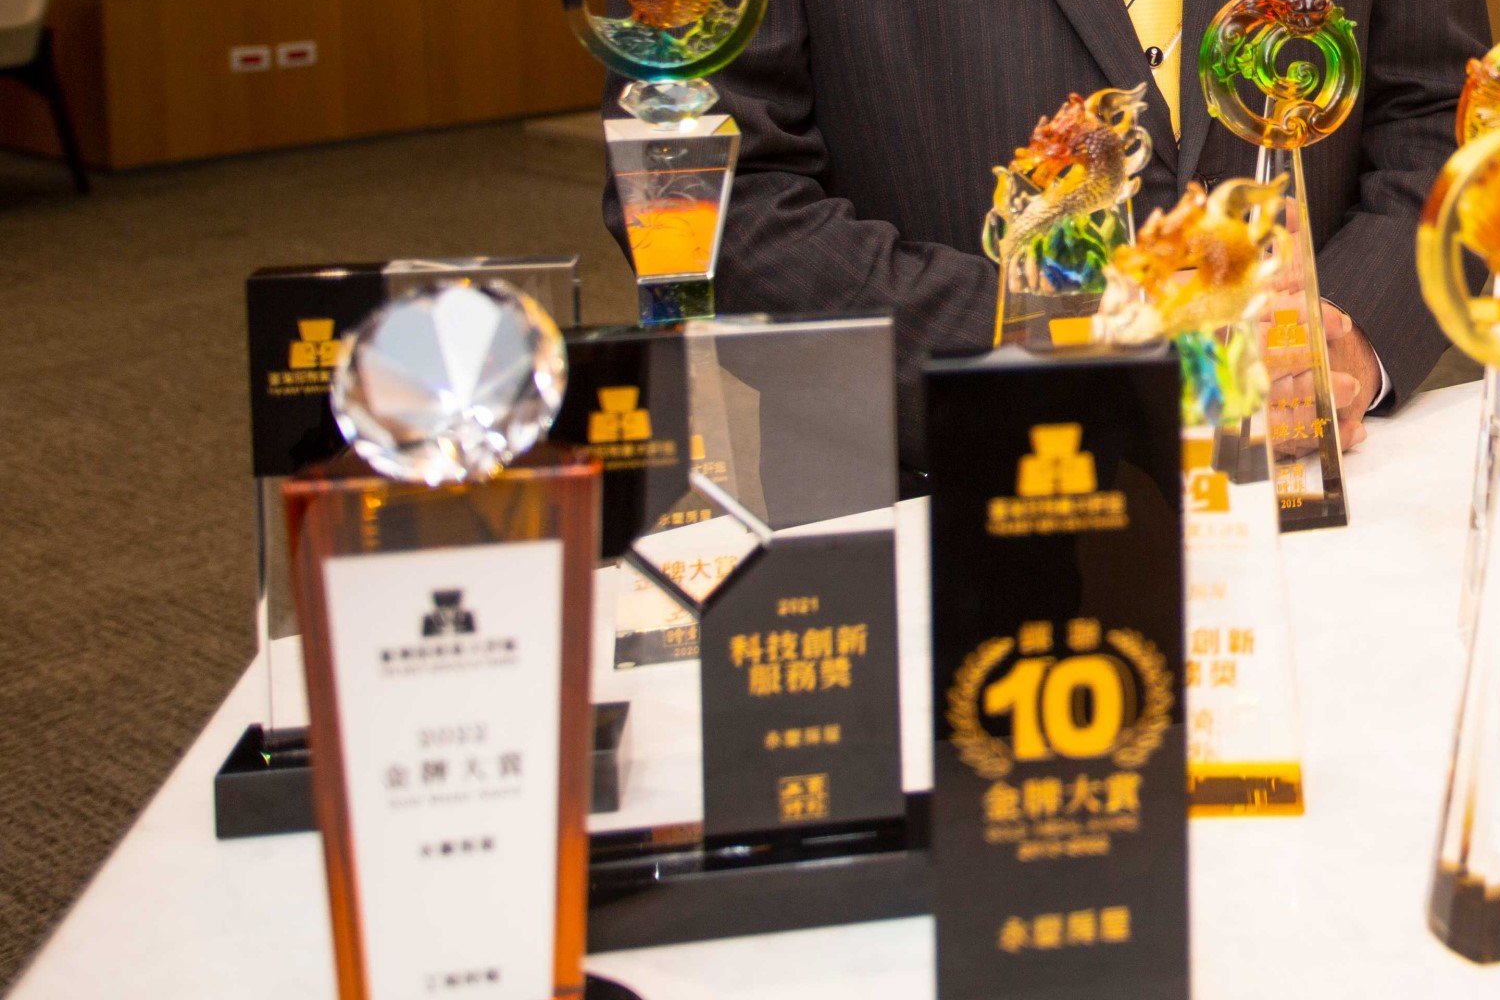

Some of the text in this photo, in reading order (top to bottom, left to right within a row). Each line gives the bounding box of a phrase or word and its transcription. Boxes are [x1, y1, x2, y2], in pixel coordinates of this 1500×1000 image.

[1281, 498, 1303, 509] 2015
[729, 623, 868, 667] 科技創新
[984, 654, 1124, 760] 10
